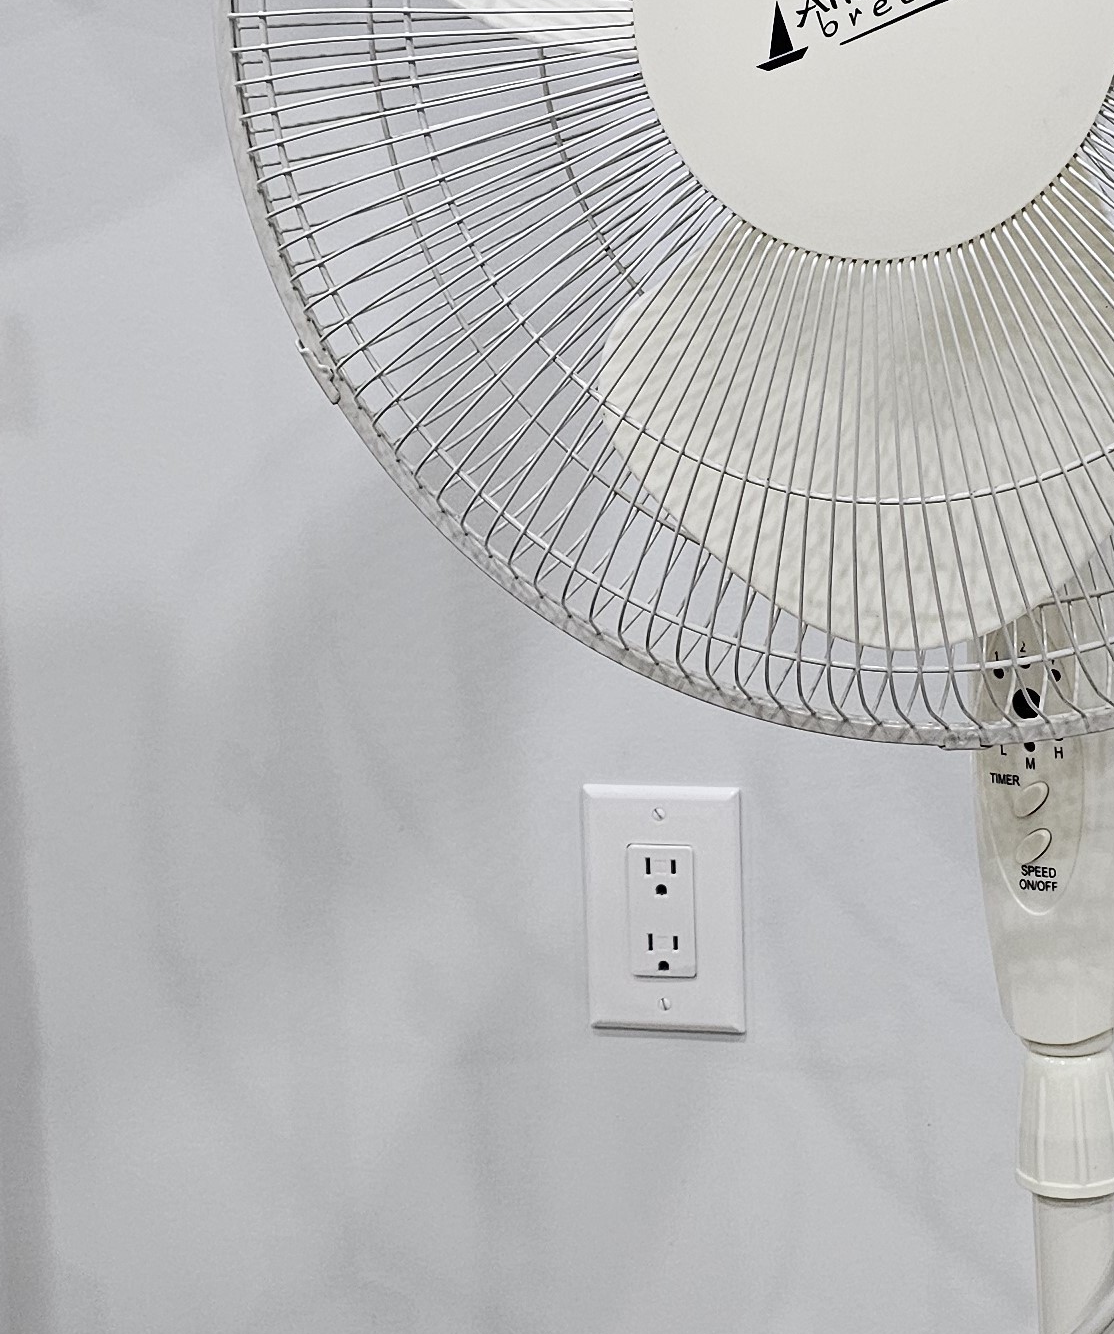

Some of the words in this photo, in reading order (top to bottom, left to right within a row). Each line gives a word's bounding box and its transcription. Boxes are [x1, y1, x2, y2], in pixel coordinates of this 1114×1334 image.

[1020, 641, 1026, 653] 2
[995, 650, 999, 661] 1
[1000, 745, 1007, 756] L
[1054, 747, 1063, 759] H
[1025, 757, 1036, 770] M
[989, 772, 1020, 786] TIMER
[1021, 865, 1057, 878] SPEED
[1019, 879, 1058, 891] ON/OFF
